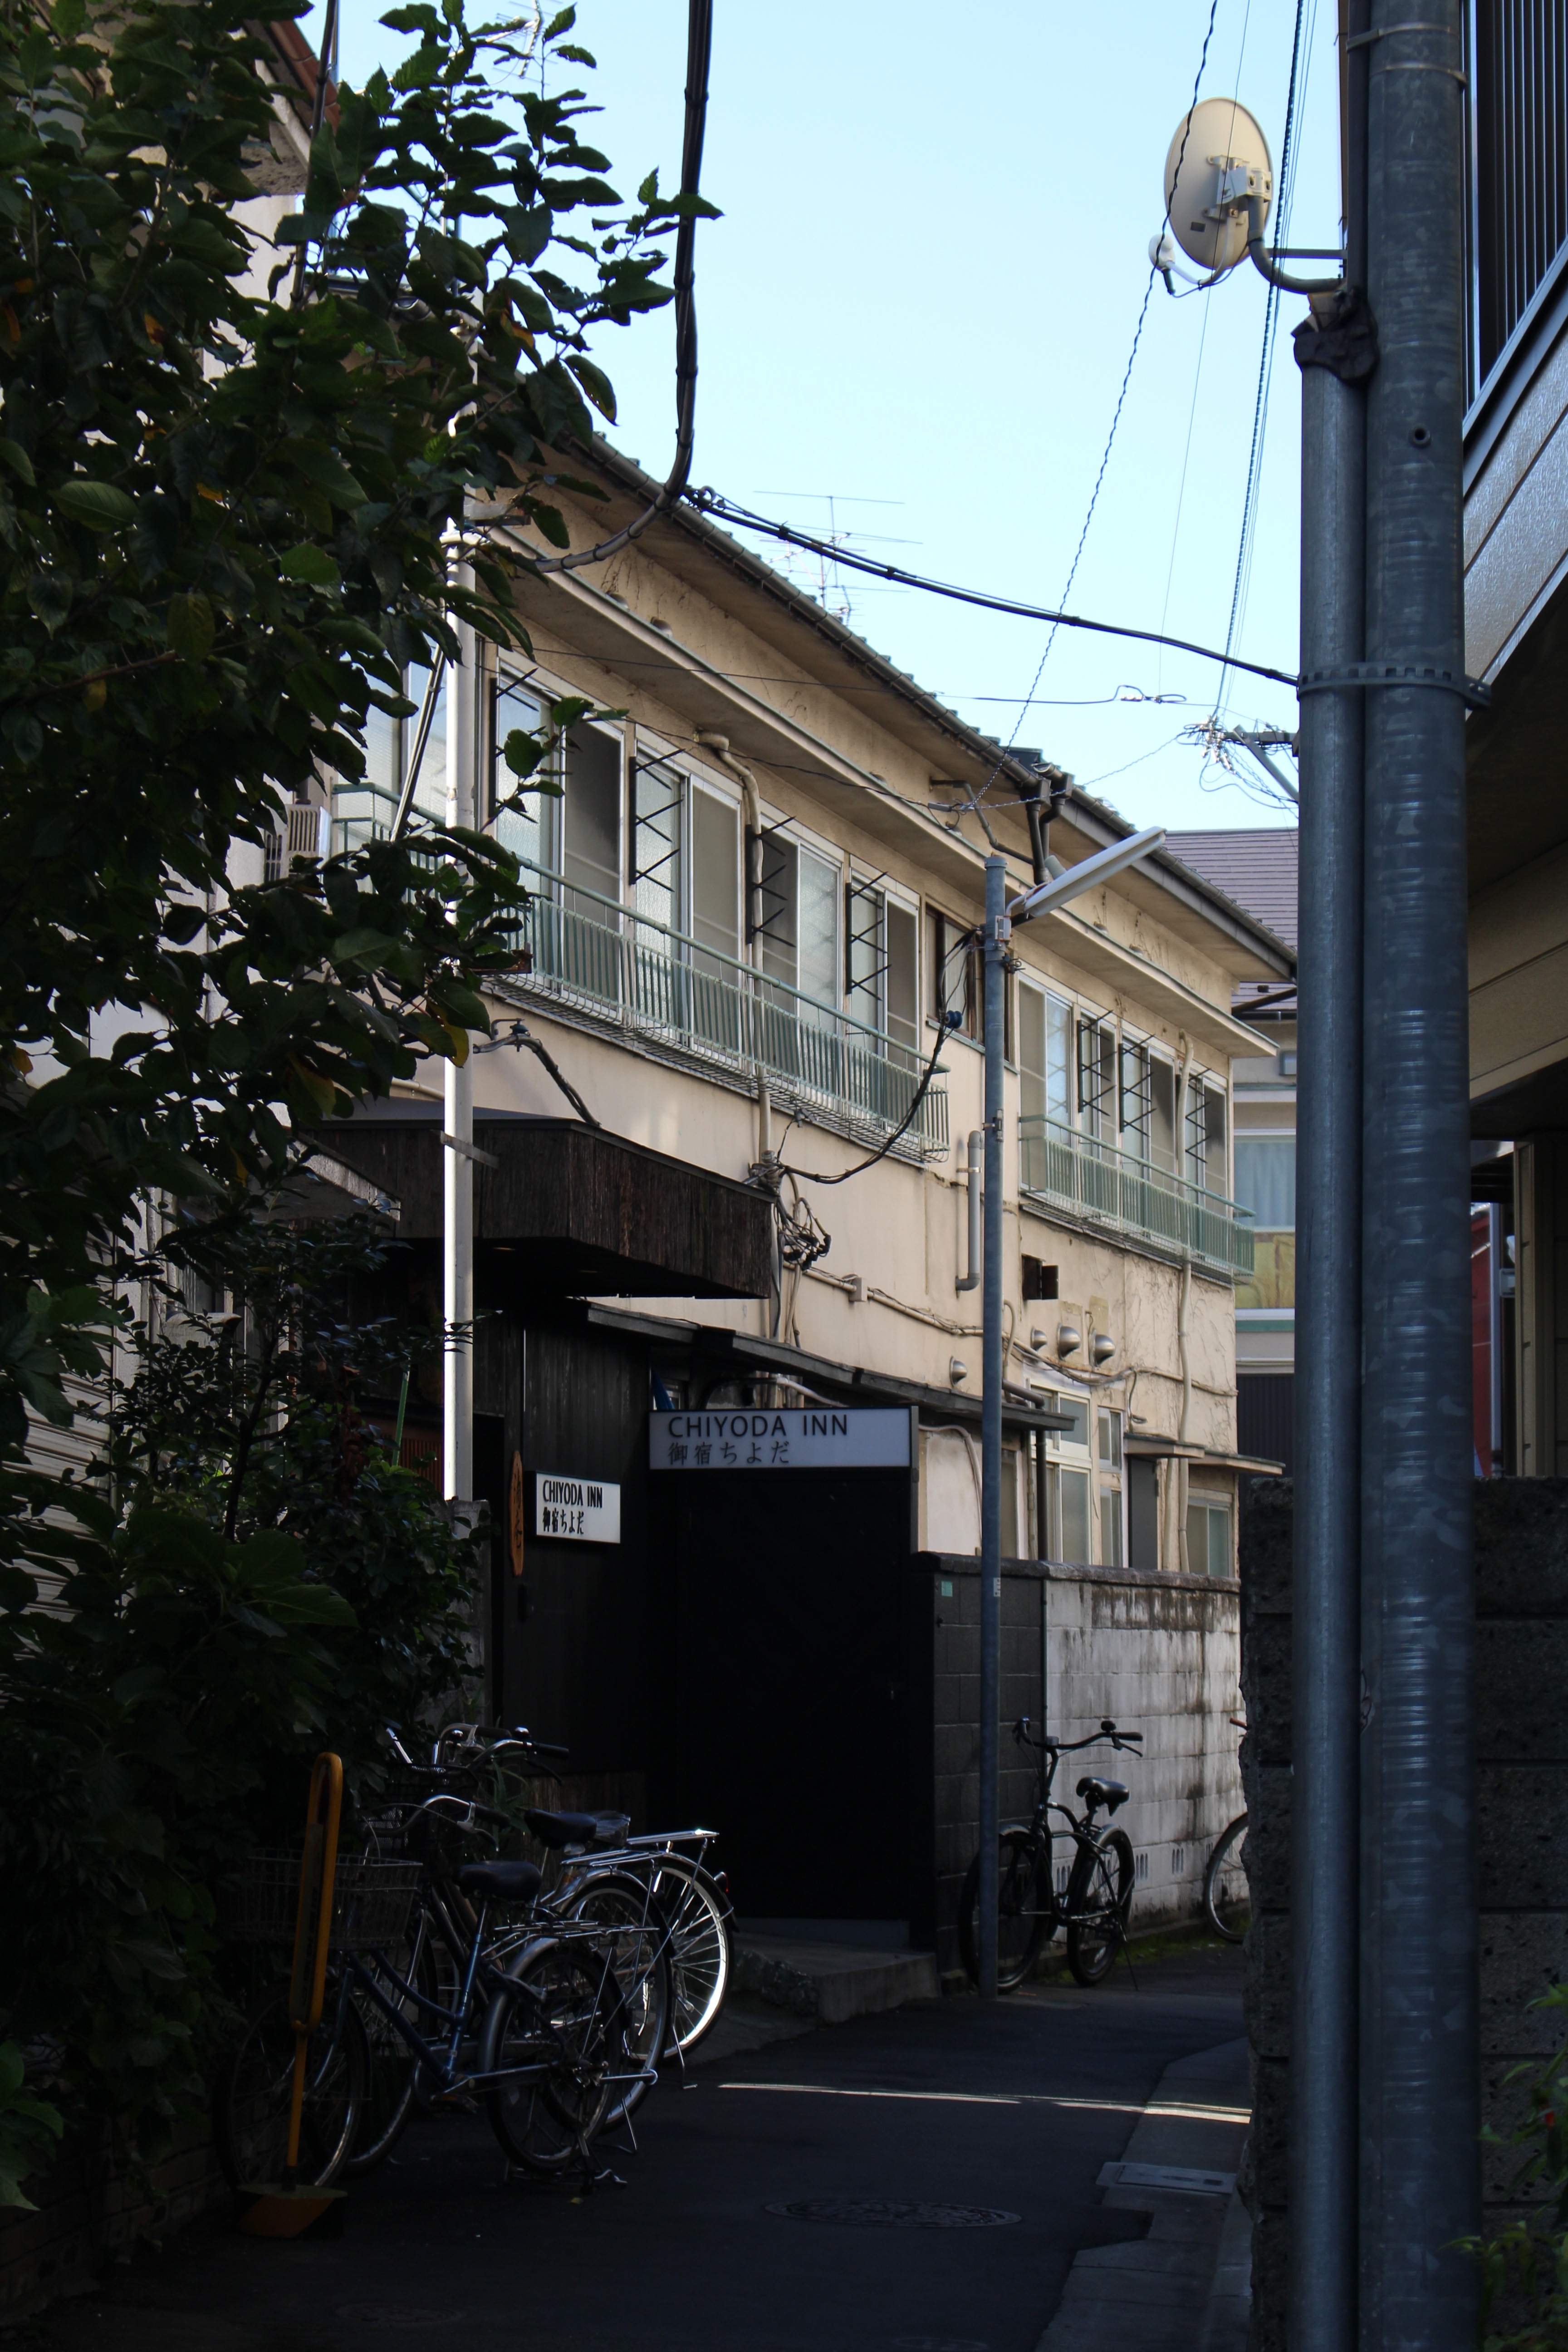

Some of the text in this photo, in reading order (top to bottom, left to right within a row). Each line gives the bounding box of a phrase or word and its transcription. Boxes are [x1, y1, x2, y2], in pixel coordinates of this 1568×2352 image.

[668, 1414, 848, 1437] CHIYODA INN
[668, 1441, 789, 1465] 御宿ちよだ
[543, 1480, 603, 1509] CHIYODA INN
[543, 1507, 584, 1534] 御宿ちよだ
